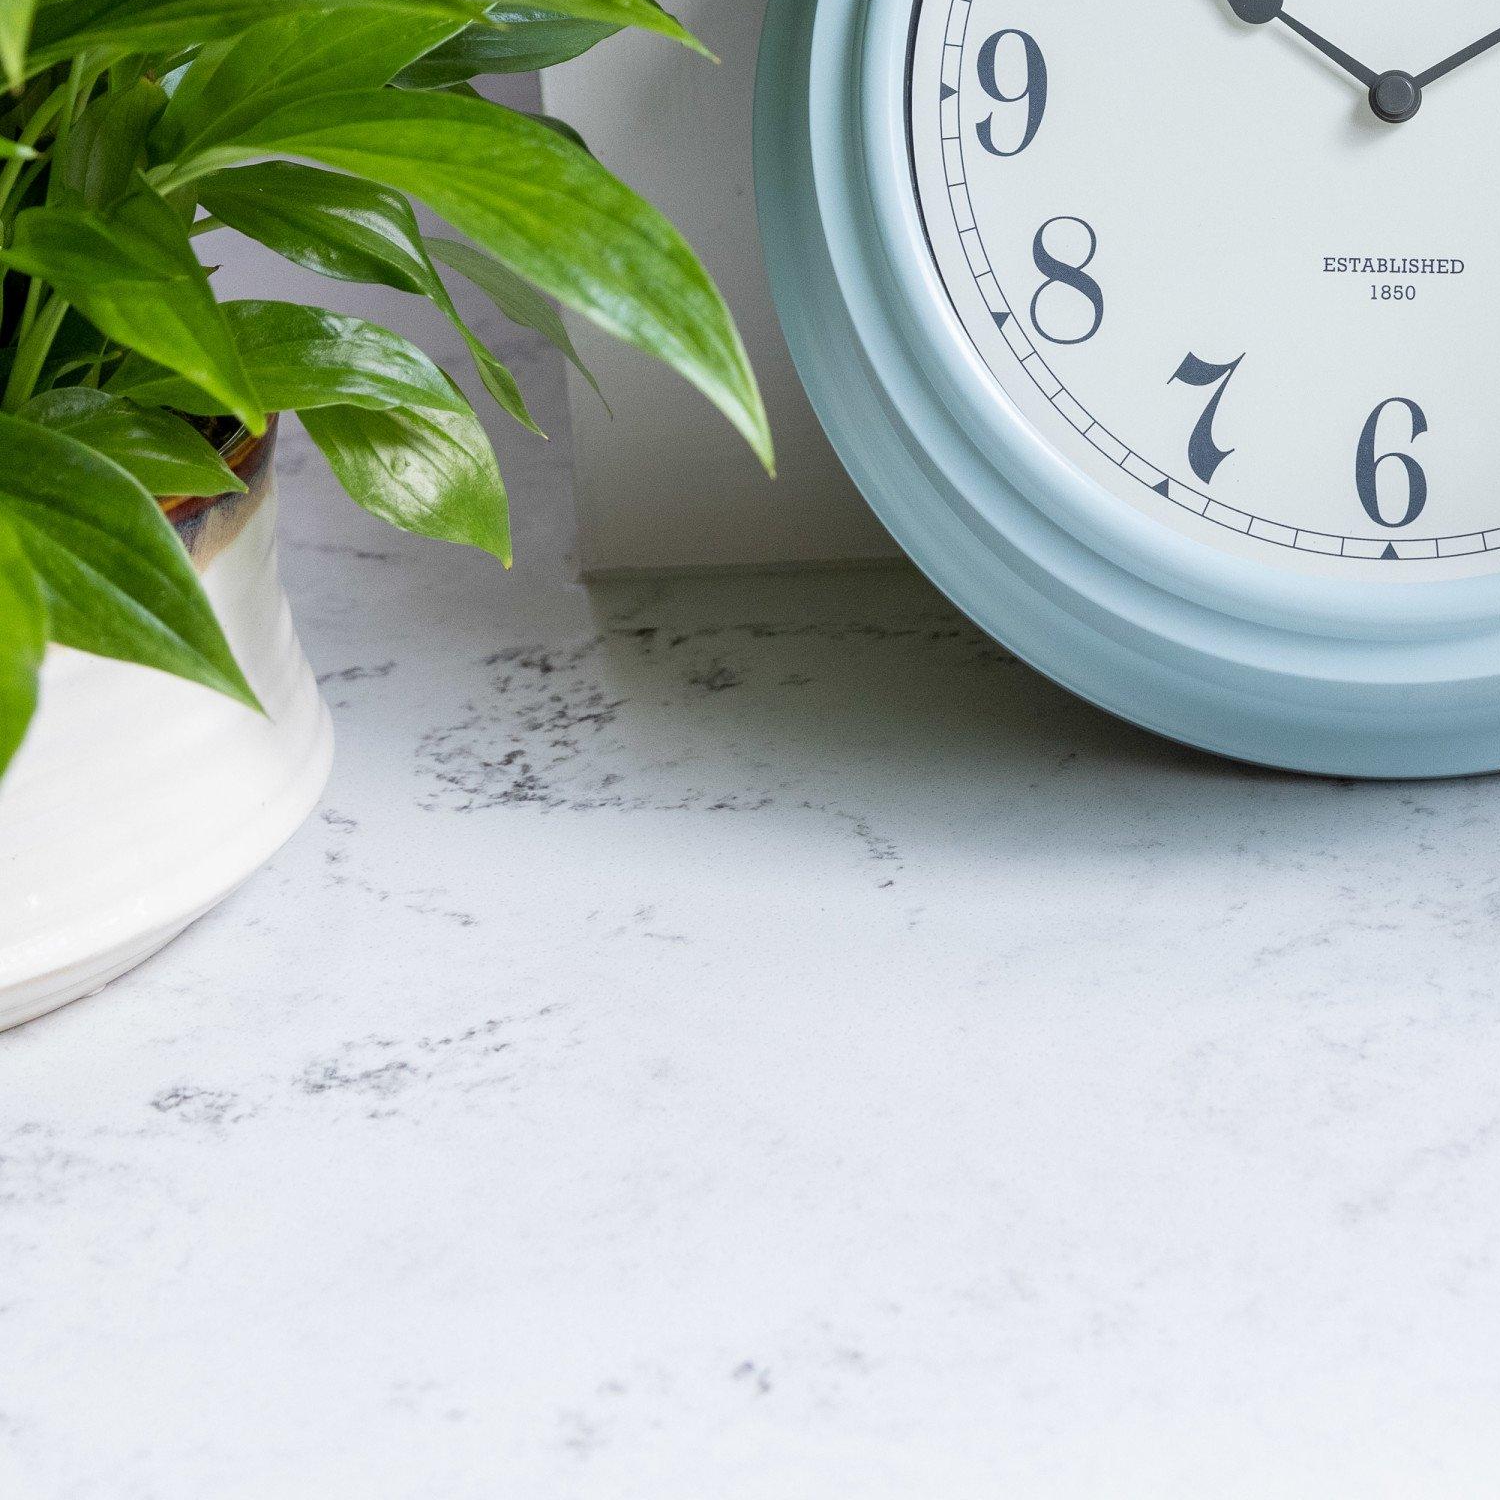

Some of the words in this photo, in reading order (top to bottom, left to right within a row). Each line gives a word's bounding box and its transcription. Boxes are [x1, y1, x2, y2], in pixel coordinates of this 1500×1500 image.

[975, 28, 1048, 157] 9
[1029, 215, 1105, 345] 8
[1322, 257, 1465, 275] ESTABLISHED
[1370, 285, 1417, 301] 1850
[1166, 351, 1246, 484] 7
[1354, 396, 1428, 528] 6
